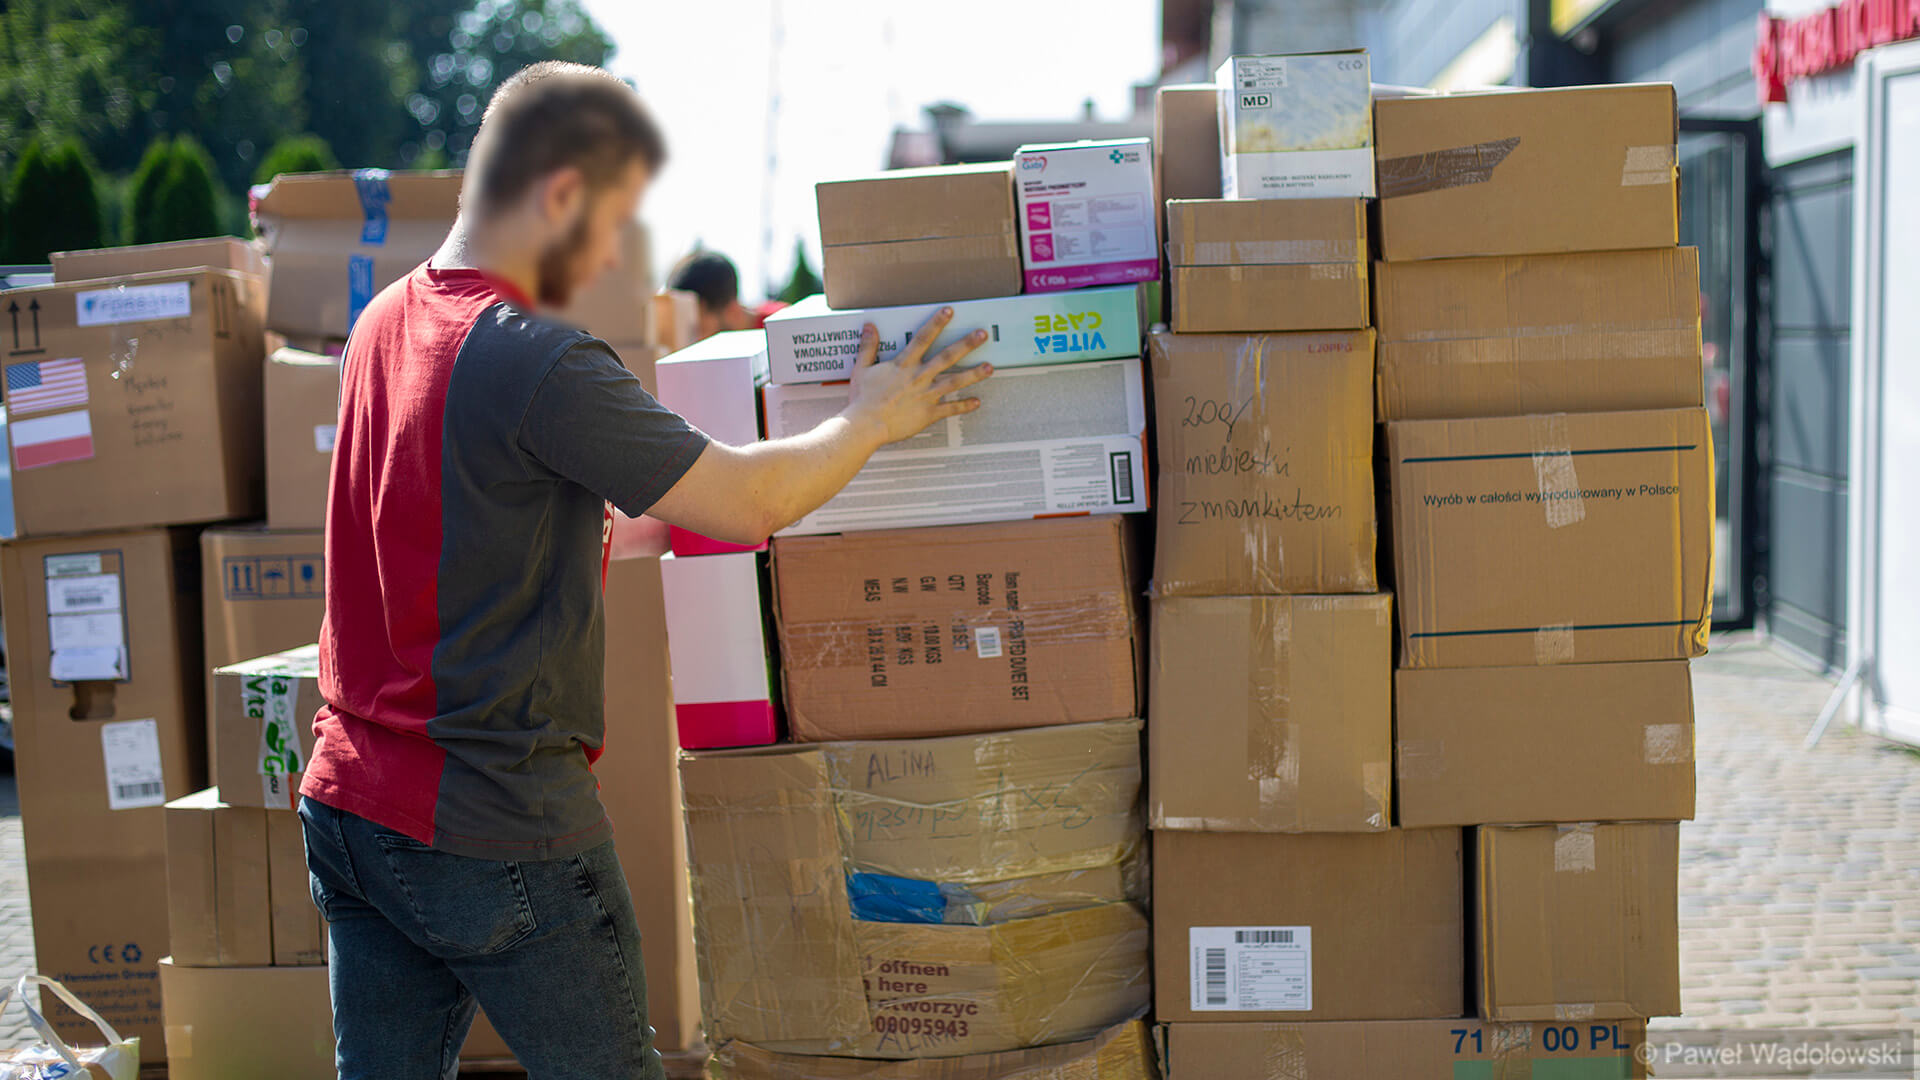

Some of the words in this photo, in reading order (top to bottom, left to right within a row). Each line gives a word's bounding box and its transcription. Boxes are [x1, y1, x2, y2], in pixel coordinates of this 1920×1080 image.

[1243, 95, 1269, 106] MD
[1033, 311, 1103, 333] CARE
[792, 329, 863, 345] NEUMATYCZNA
[1034, 331, 1107, 354] VITEA
[795, 359, 844, 373] PODUSZKA
[1424, 493, 1463, 508] Wyrób
[1466, 496, 1476, 504] w
[1480, 489, 1522, 504] całości
[1525, 485, 1622, 505] wyprodukowany
[1625, 488, 1636, 497] w
[1639, 484, 1679, 496] Polsce
[863, 578, 881, 602] MEAS
[947, 574, 966, 591] QTY
[976, 573, 994, 606] Barcode
[953, 634, 969, 651] SET
[925, 646, 942, 664] KGS
[1012, 685, 1030, 701] SET
[878, 976, 928, 993] here
[1450, 1028, 1483, 1054] 71
[1542, 1027, 1579, 1052] 00
[1590, 1025, 1630, 1050] PL
